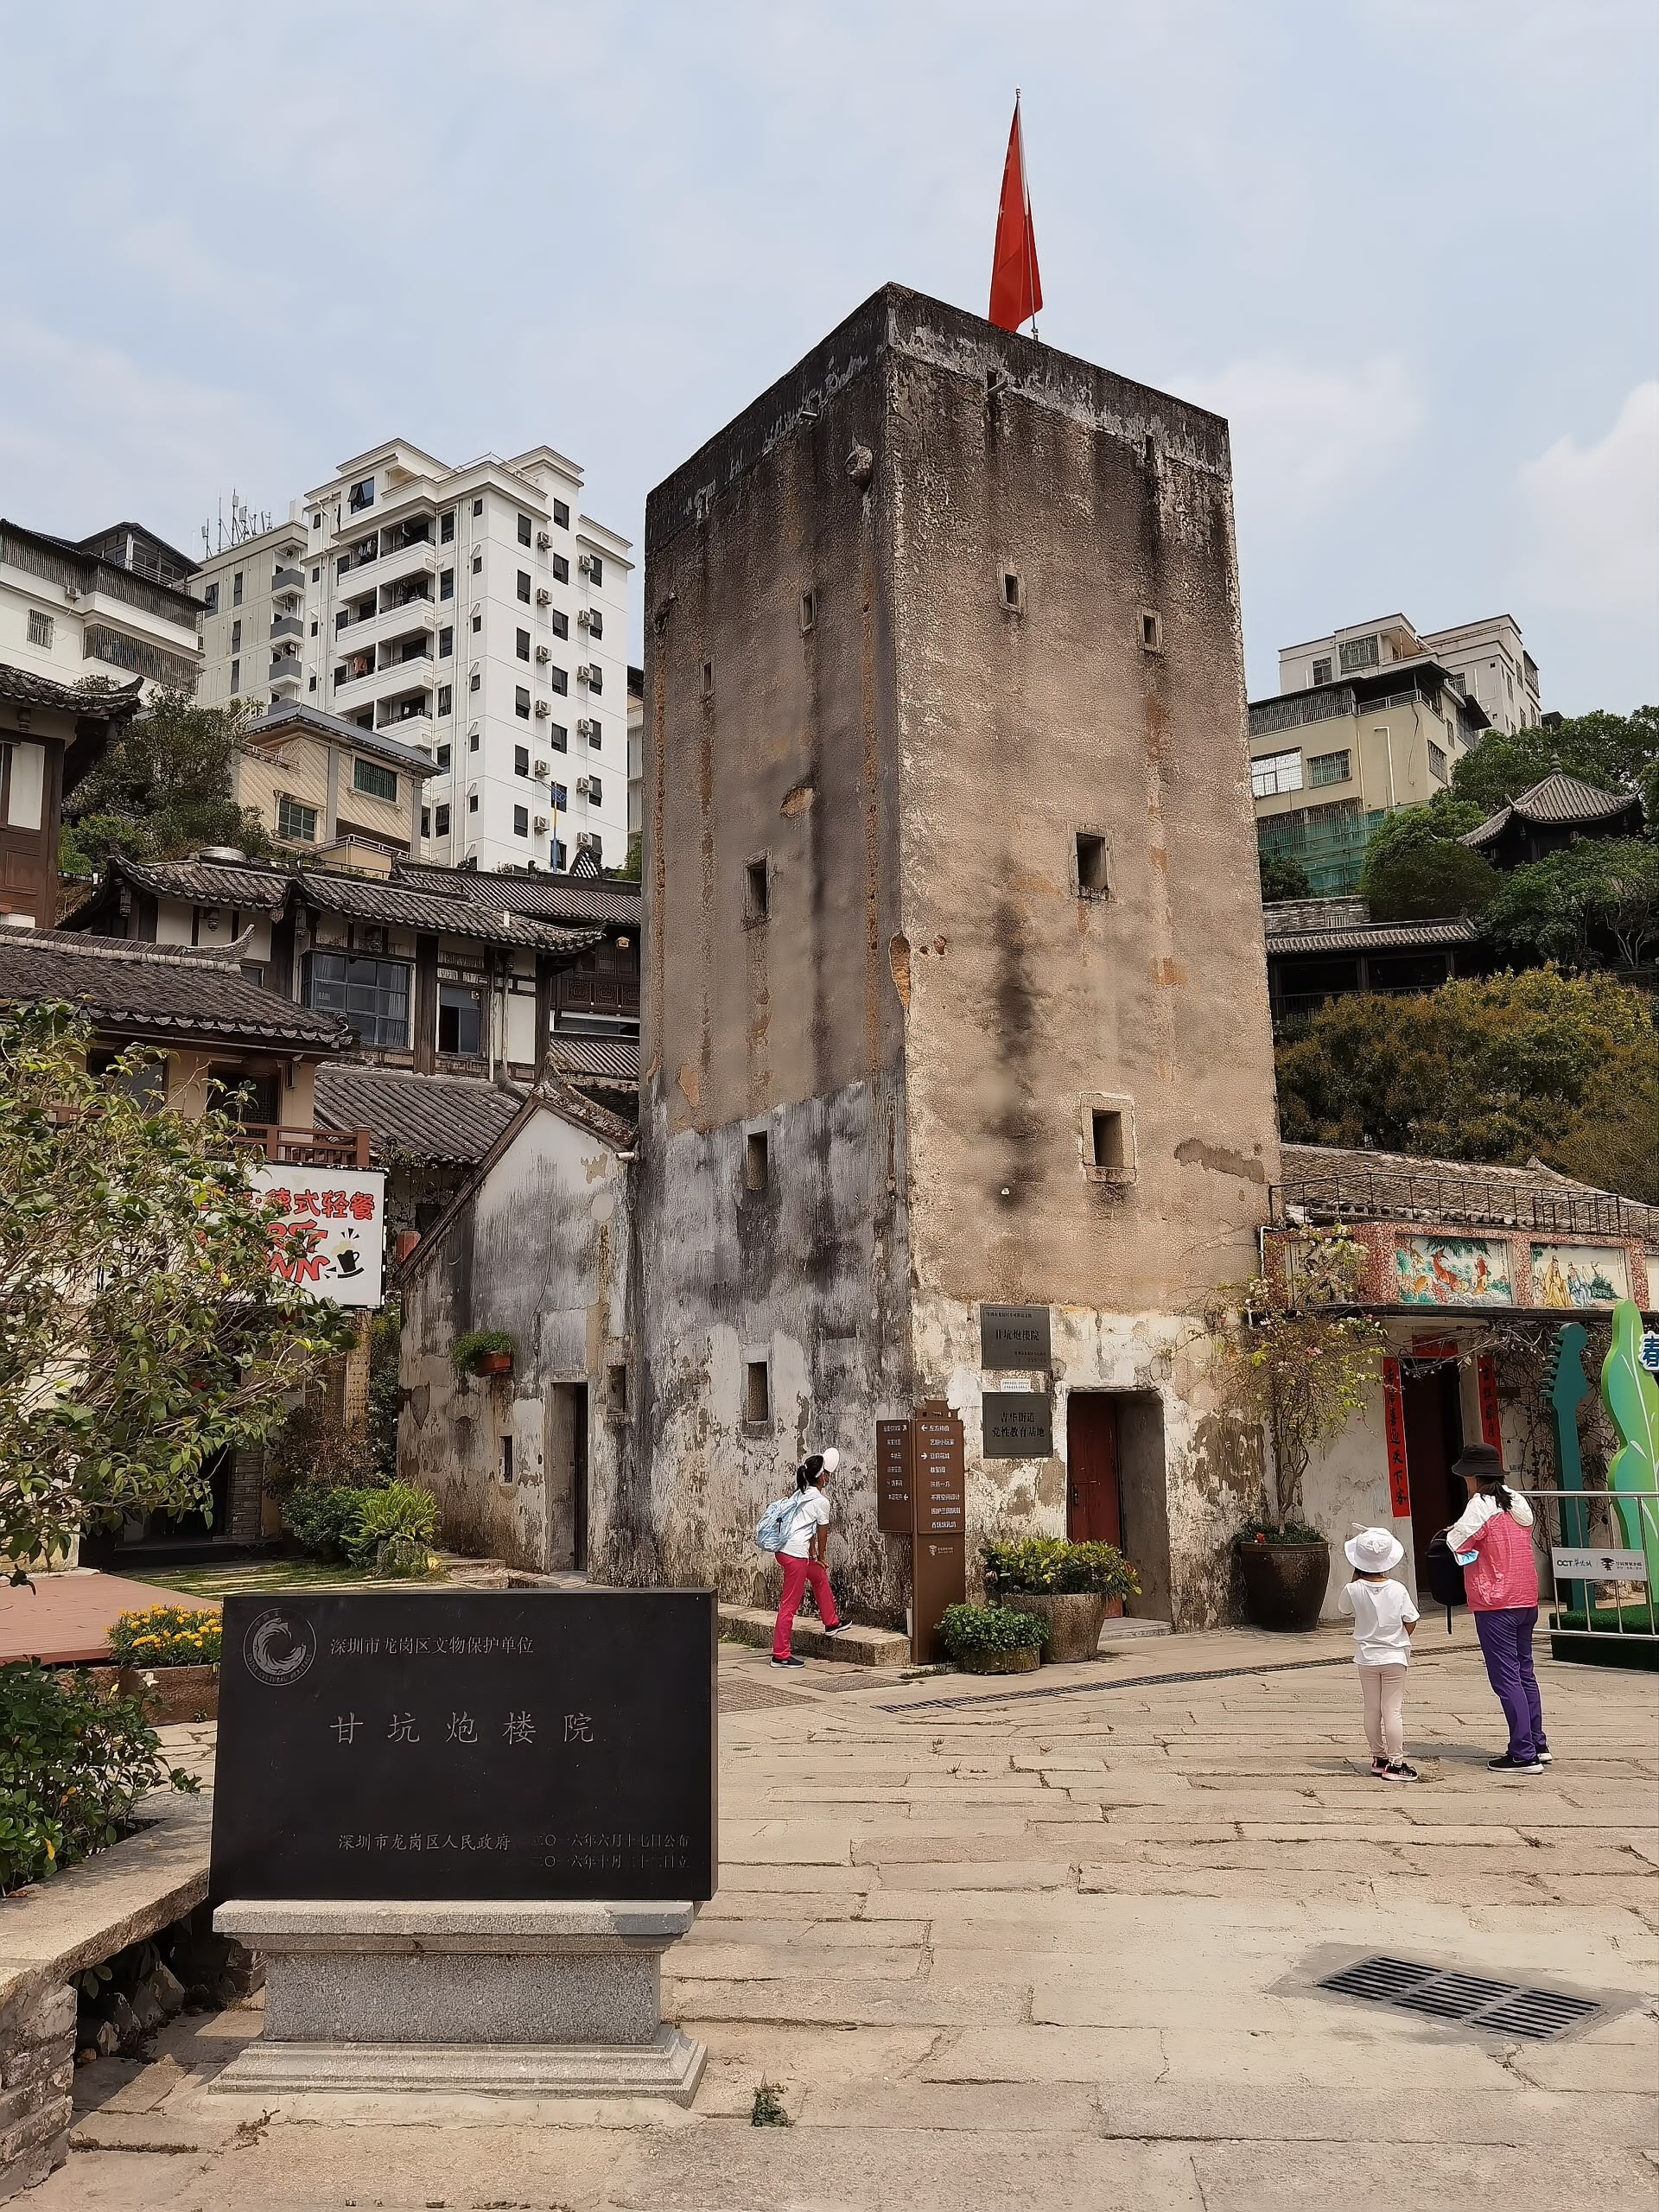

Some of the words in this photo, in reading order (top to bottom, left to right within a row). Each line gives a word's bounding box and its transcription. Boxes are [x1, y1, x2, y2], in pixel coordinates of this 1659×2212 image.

[1001, 1411, 1035, 1423] 吉华街道
[992, 1426, 1045, 1438] 党性教育基地
[329, 1635, 534, 1656] 深圳市龙岗区文物保护单位
[329, 1711, 595, 1745] 甘坑炮楼院
[338, 1832, 512, 1852] 深圳市龙岗区人民政府
